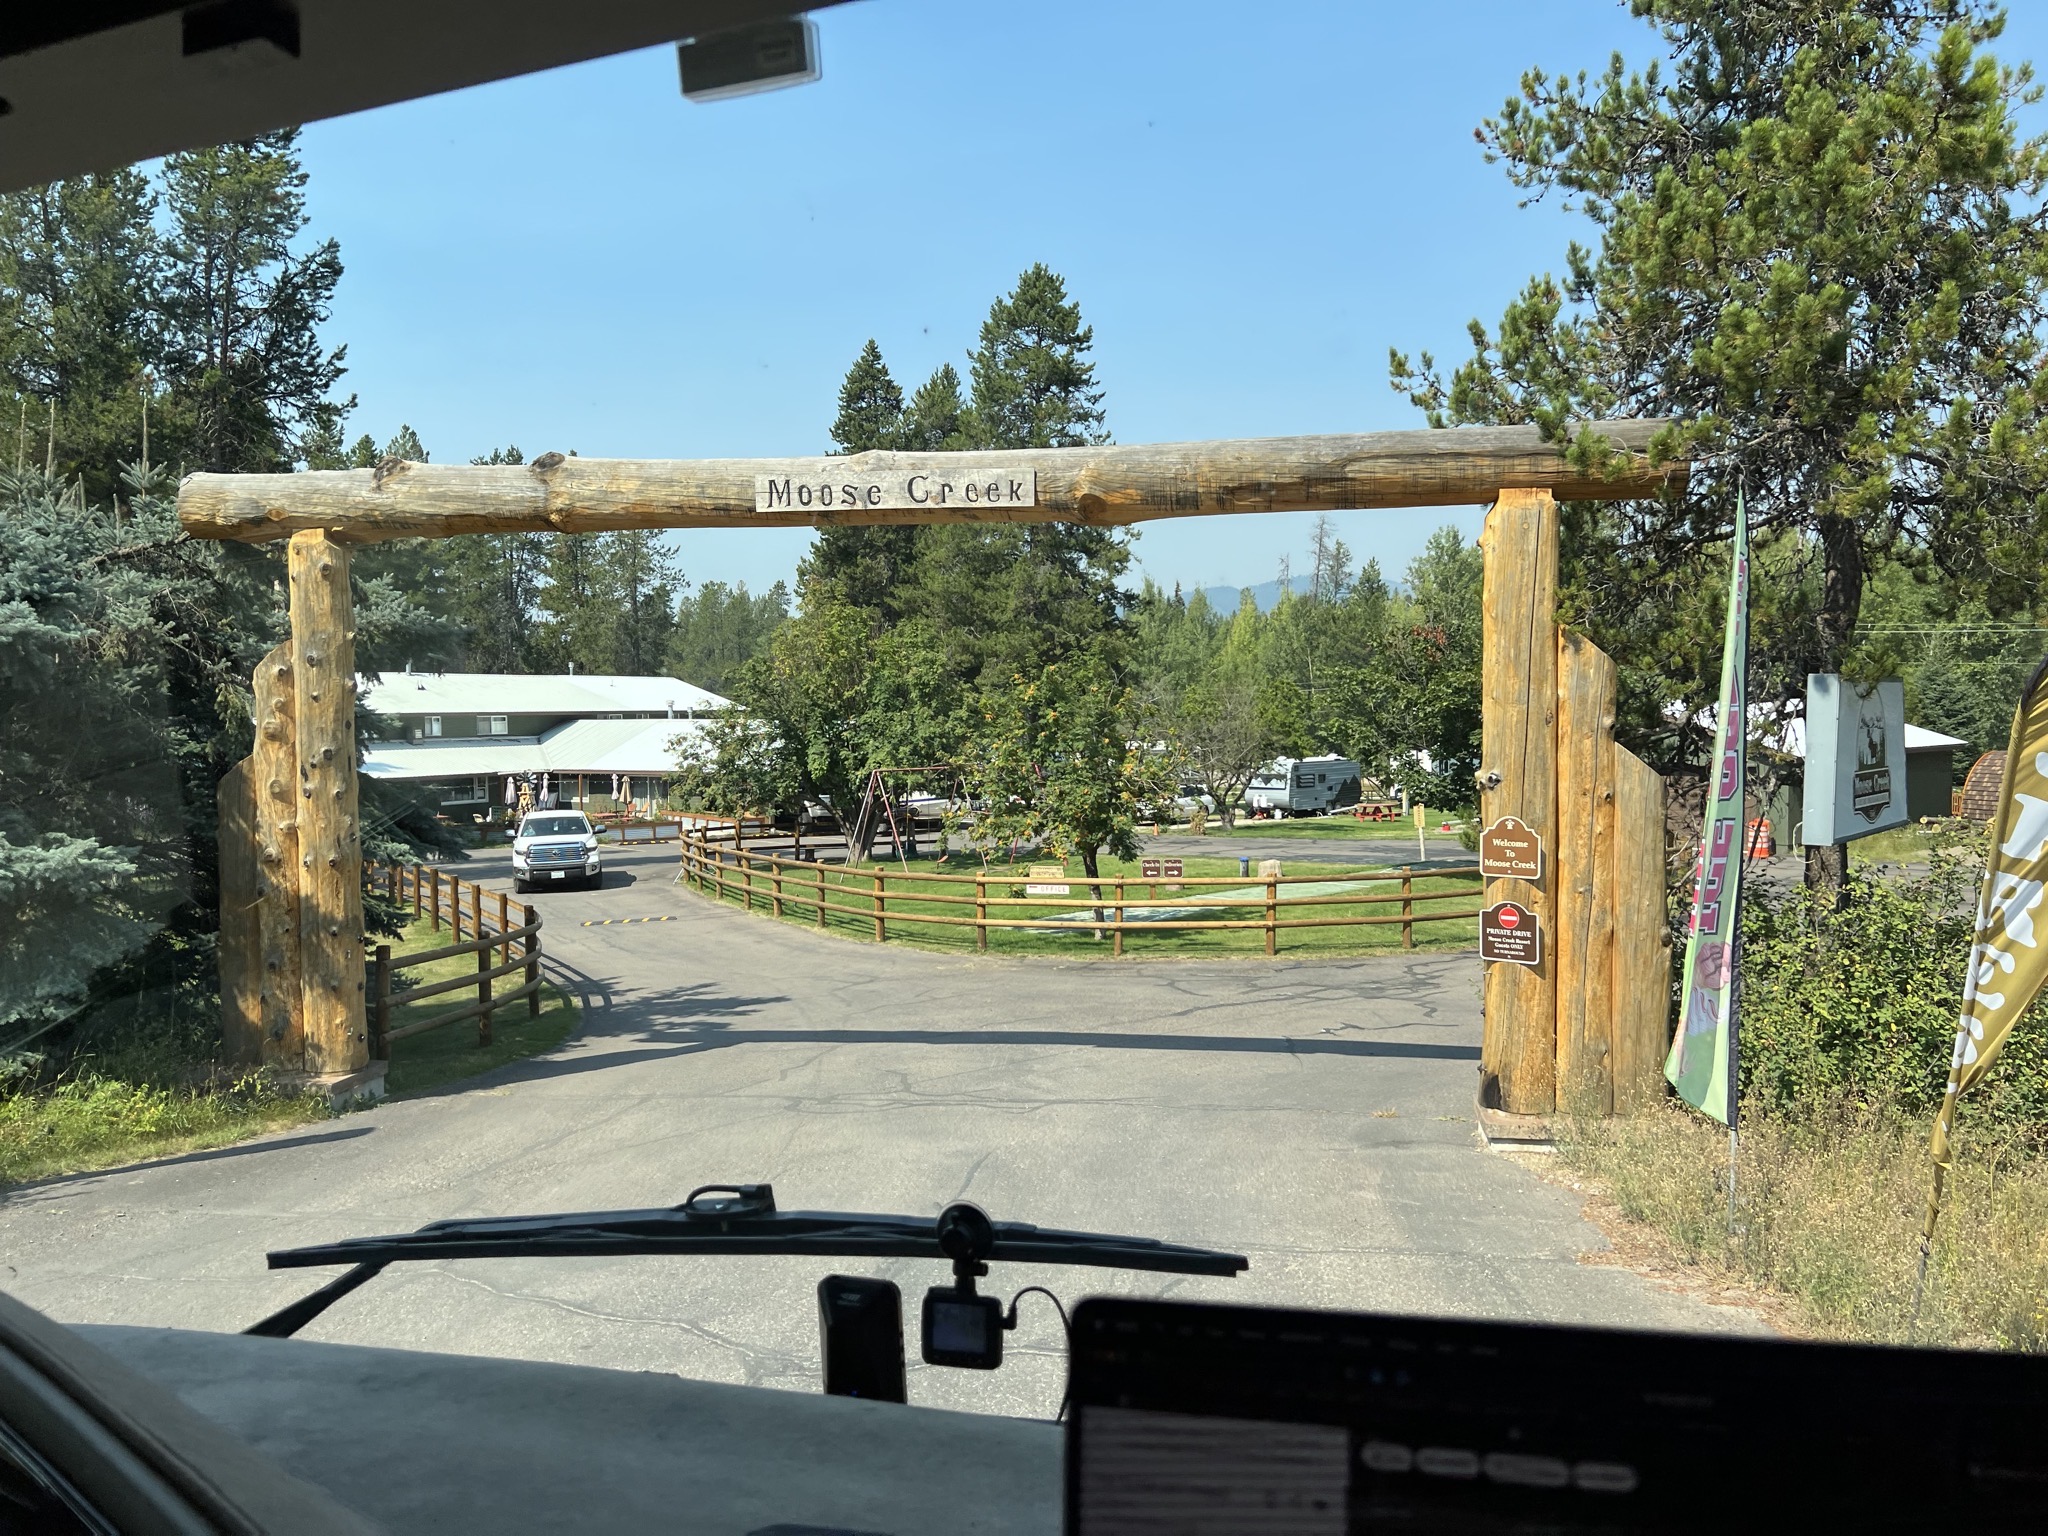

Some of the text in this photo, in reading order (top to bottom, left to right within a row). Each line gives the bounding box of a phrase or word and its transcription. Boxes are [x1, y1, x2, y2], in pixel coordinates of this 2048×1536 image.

[767, 475, 1024, 508] Moose Creek
[1492, 838, 1529, 848] Welcome
[1504, 849, 1516, 858] To
[1484, 858, 1537, 870] Moose Creek
[1486, 927, 1532, 938] PRIVATE DRIVE
